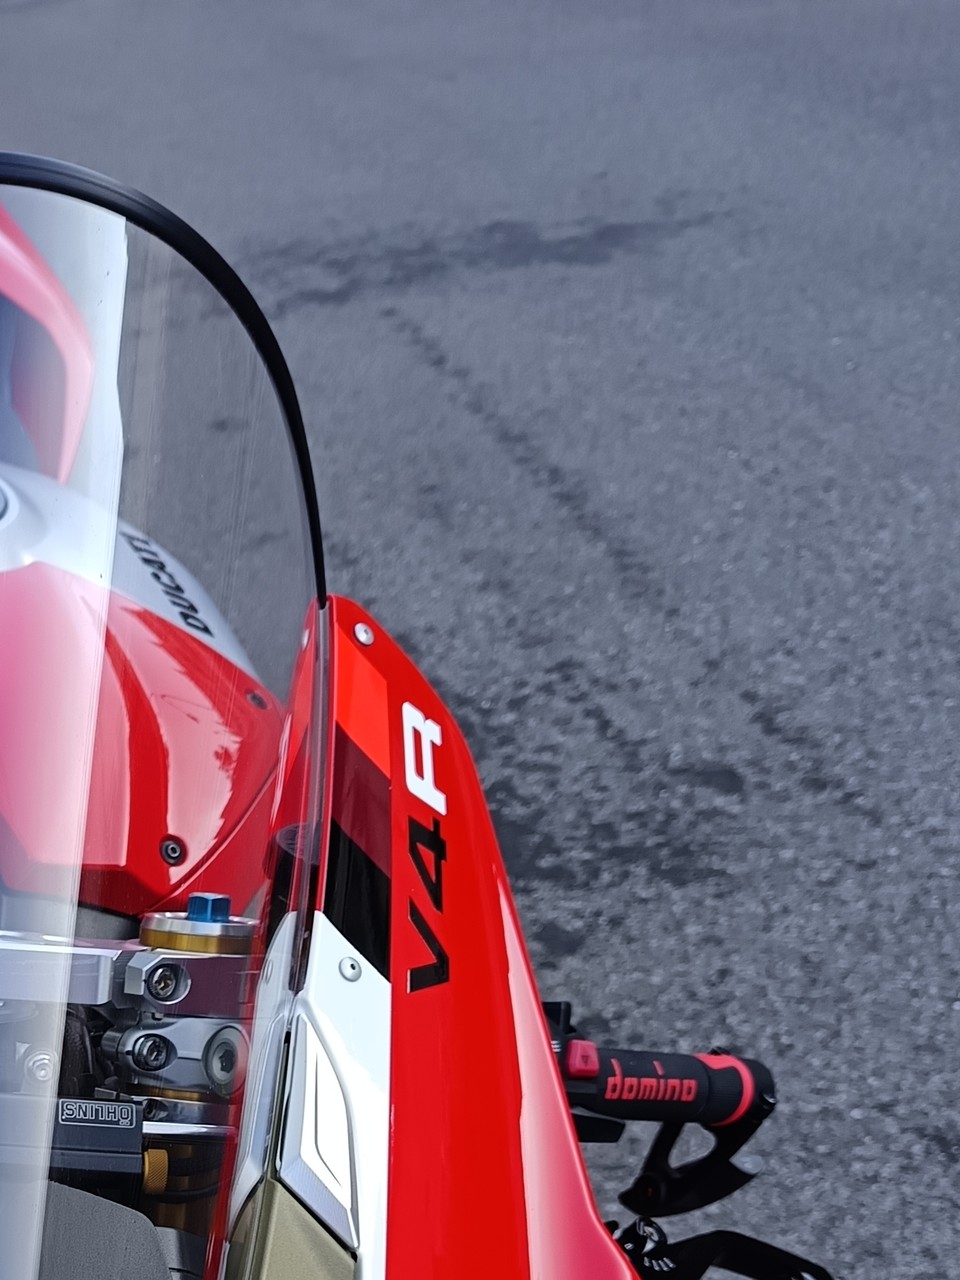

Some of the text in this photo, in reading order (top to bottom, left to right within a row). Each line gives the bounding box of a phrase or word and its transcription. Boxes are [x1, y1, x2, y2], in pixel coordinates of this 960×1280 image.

[120, 532, 215, 638] DUCATI
[605, 1058, 698, 1101] domino
[63, 1102, 132, 1126] ÖHLINS
